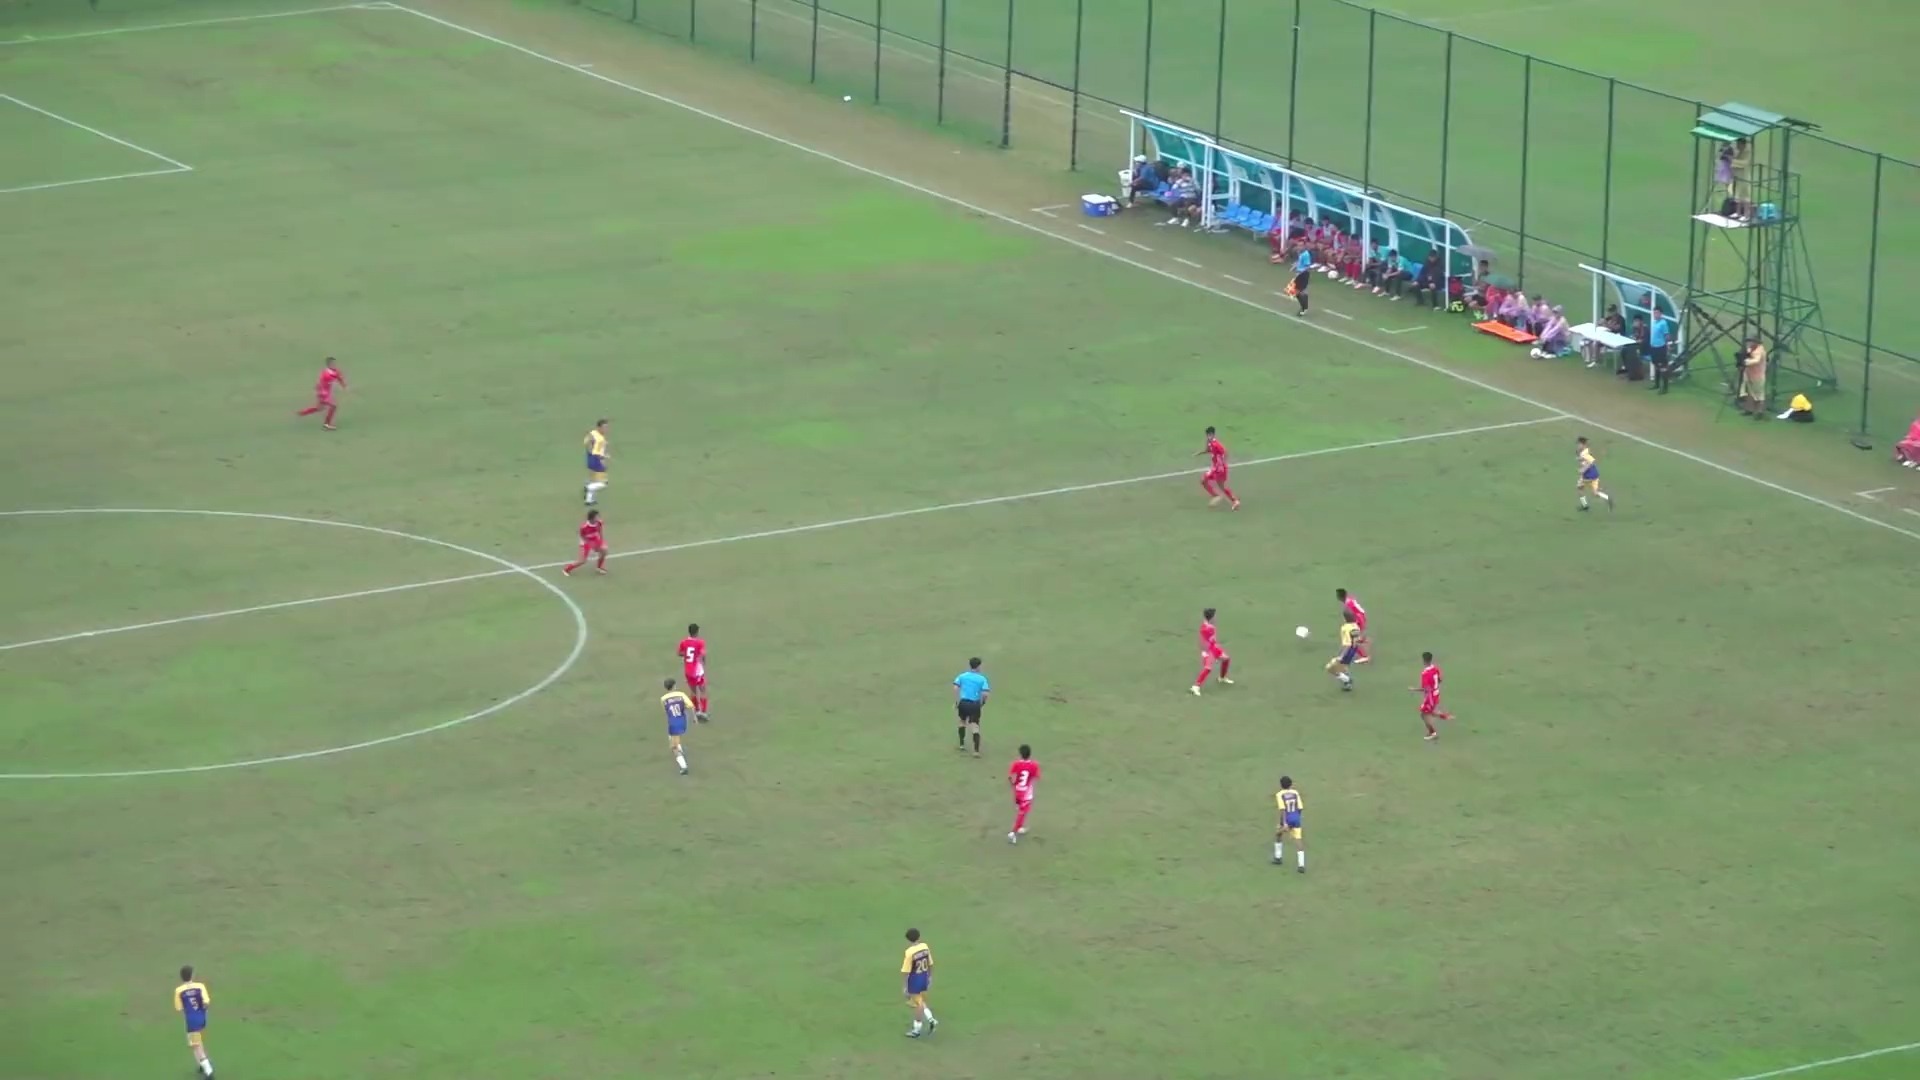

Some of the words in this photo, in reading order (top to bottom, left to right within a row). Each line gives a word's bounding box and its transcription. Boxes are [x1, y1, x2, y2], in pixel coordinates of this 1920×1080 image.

[686, 646, 696, 663] 5
[669, 703, 682, 717] 10
[1018, 769, 1030, 786] 3
[915, 958, 928, 974] 20
